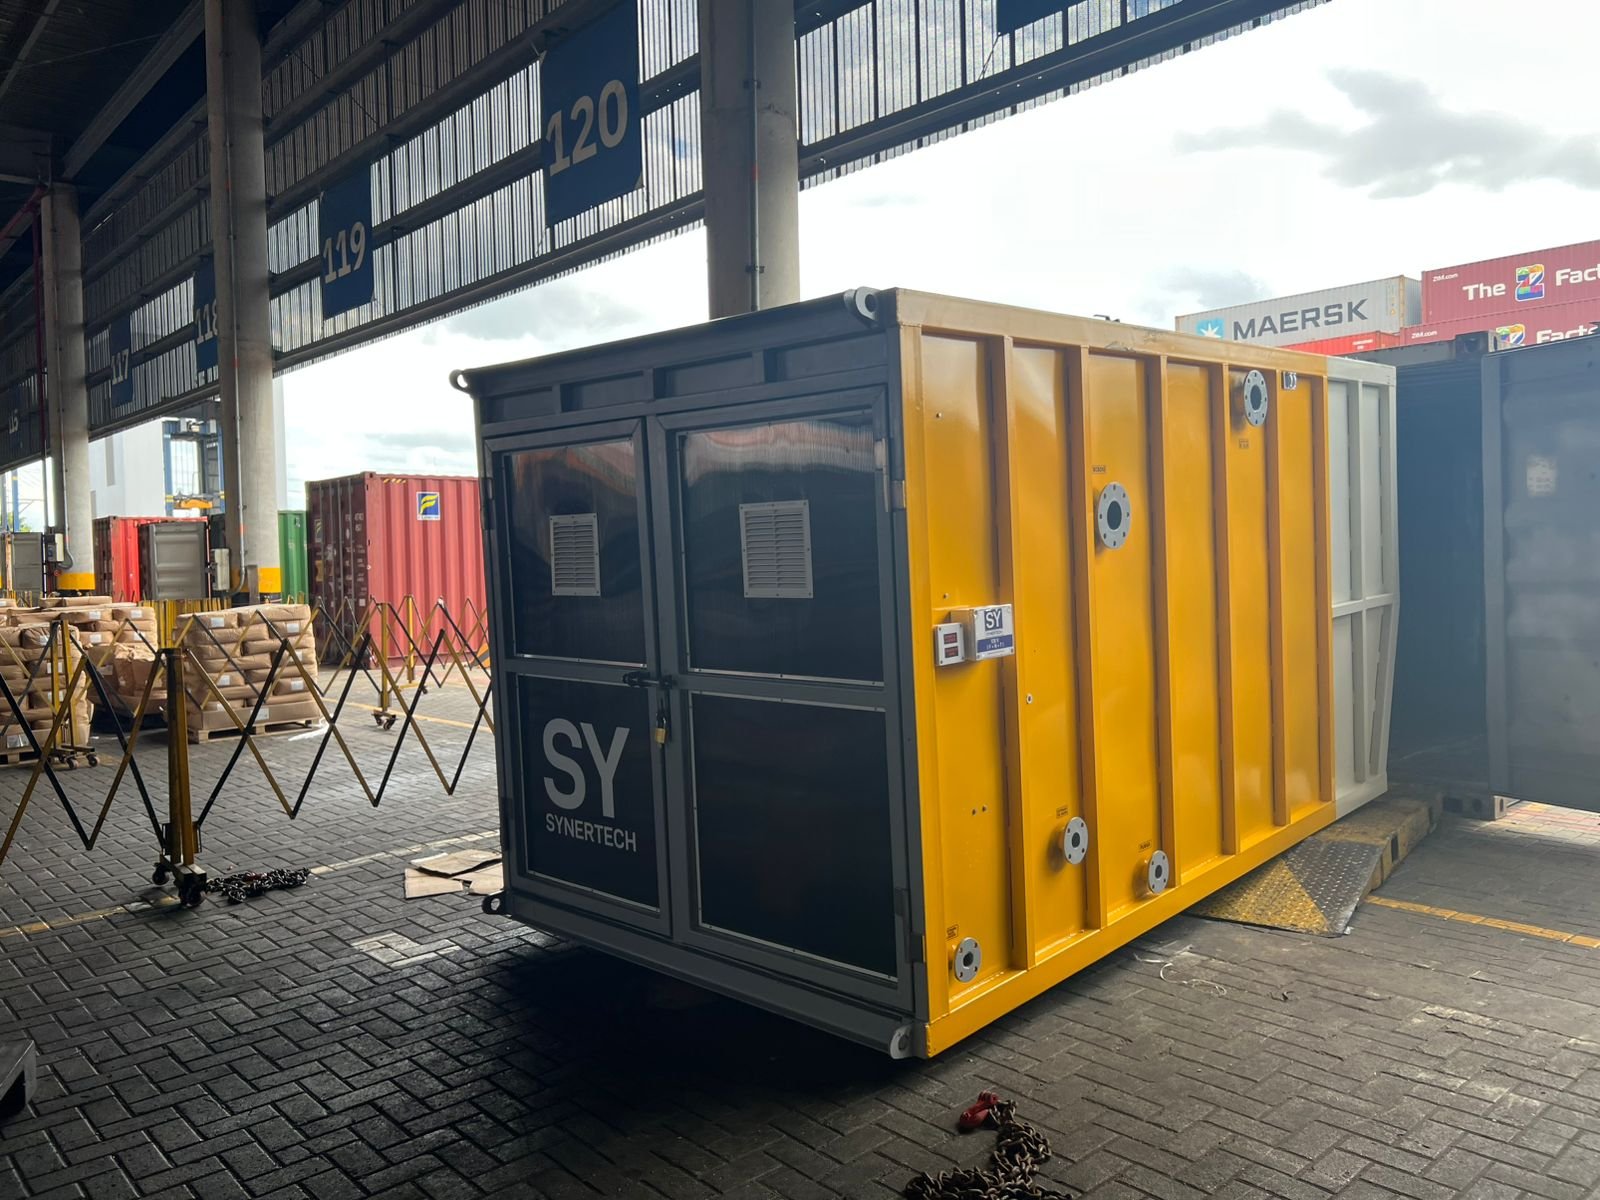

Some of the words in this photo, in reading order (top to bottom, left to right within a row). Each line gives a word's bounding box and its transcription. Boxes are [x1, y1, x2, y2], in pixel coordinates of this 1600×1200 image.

[545, 79, 628, 177] 120
[322, 221, 366, 284] 119
[1462, 282, 1506, 301] The
[1233, 298, 1369, 341] MAERSK
[111, 348, 129, 385] 117
[985, 609, 1001, 629] SY
[542, 717, 630, 819] SY
[545, 812, 637, 852] SYNERTECH
